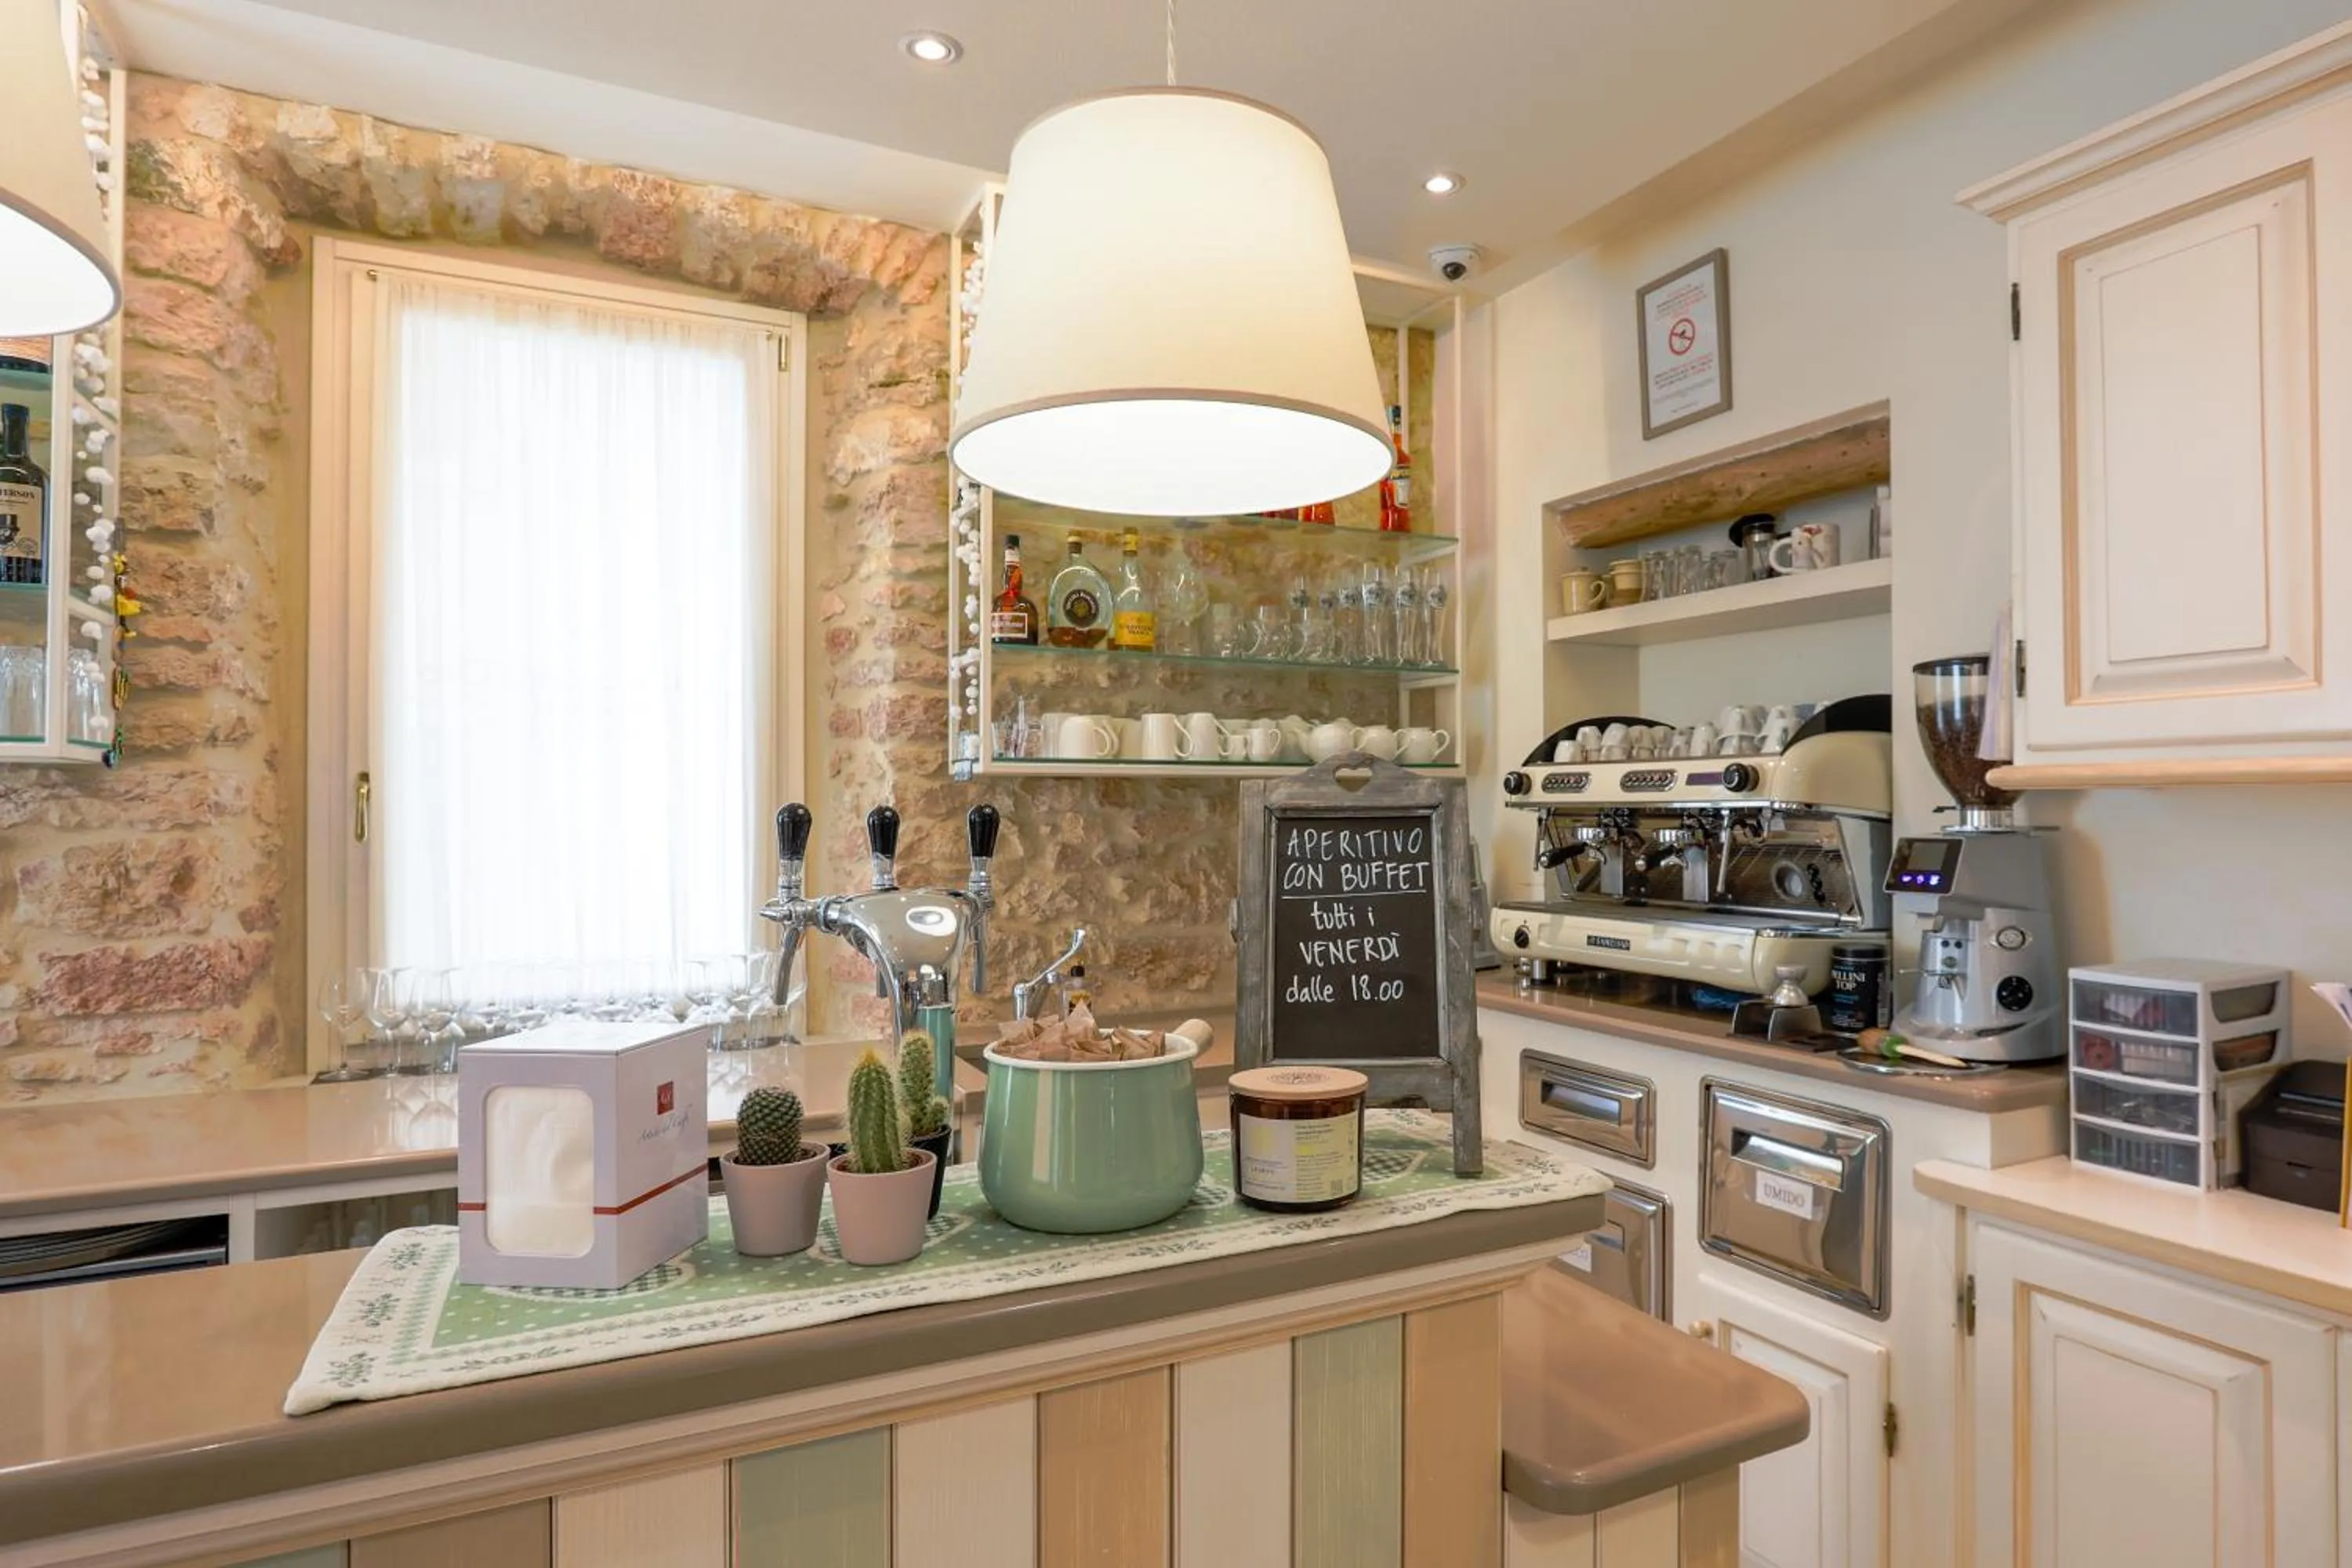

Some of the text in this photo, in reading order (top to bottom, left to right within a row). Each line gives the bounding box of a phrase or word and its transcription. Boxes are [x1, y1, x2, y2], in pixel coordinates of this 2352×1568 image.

[1287, 827, 1423, 861] APERITIVO
[1283, 862, 1430, 891] CON BUFFET
[1311, 901, 1374, 930] tutti i
[1299, 932, 1400, 967] VENERDÌ
[1286, 974, 1404, 1003] dalle 18.00
[1763, 1182, 1806, 1207] UMIDO
